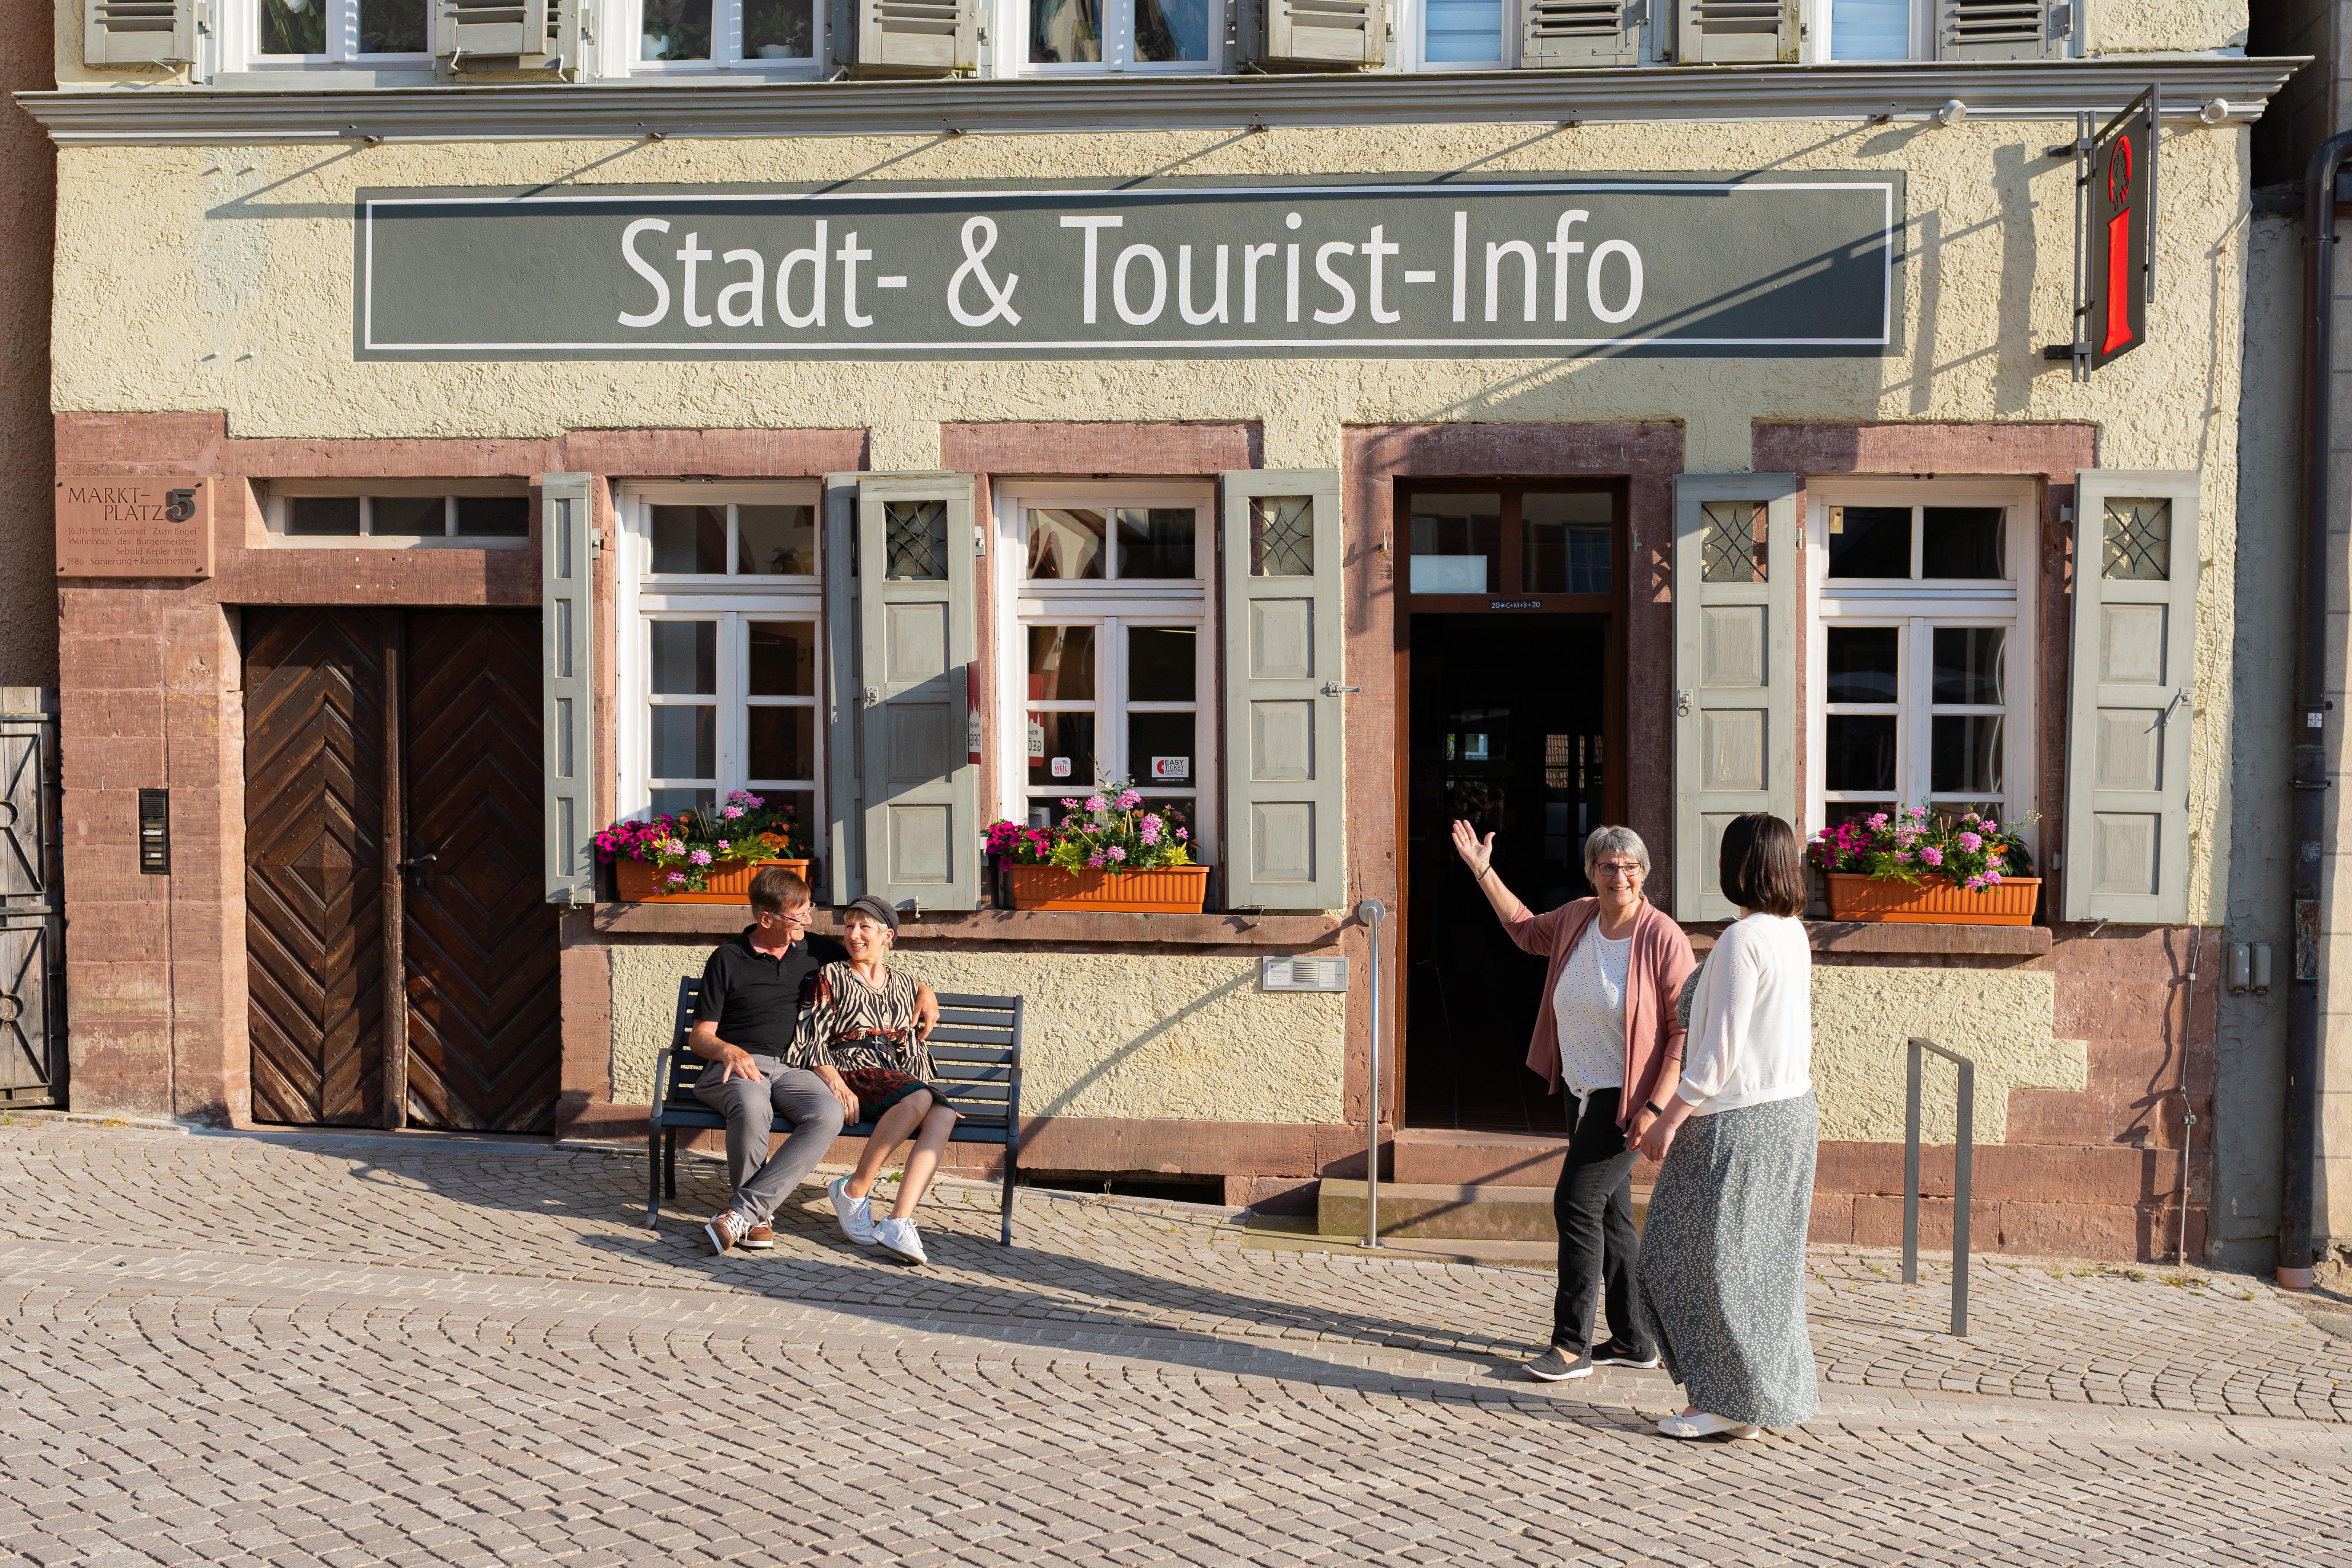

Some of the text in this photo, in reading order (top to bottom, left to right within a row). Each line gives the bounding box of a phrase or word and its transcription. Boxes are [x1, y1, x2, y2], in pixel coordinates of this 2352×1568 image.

[618, 210, 1644, 328] Stadt- & Tourist-Info
[68, 487, 150, 503] MARKT-
[172, 489, 196, 520] 5
[104, 505, 164, 521] PLATZ
[114, 527, 146, 535] Gasthof
[67, 537, 197, 547] Wohnhaus des Bürgermeisters
[115, 547, 143, 556] Sebald
[146, 547, 171, 557] Kepler
[67, 557, 84, 565] 1986
[90, 557, 132, 567] Sanierung
[140, 557, 196, 566] Restaurierung
